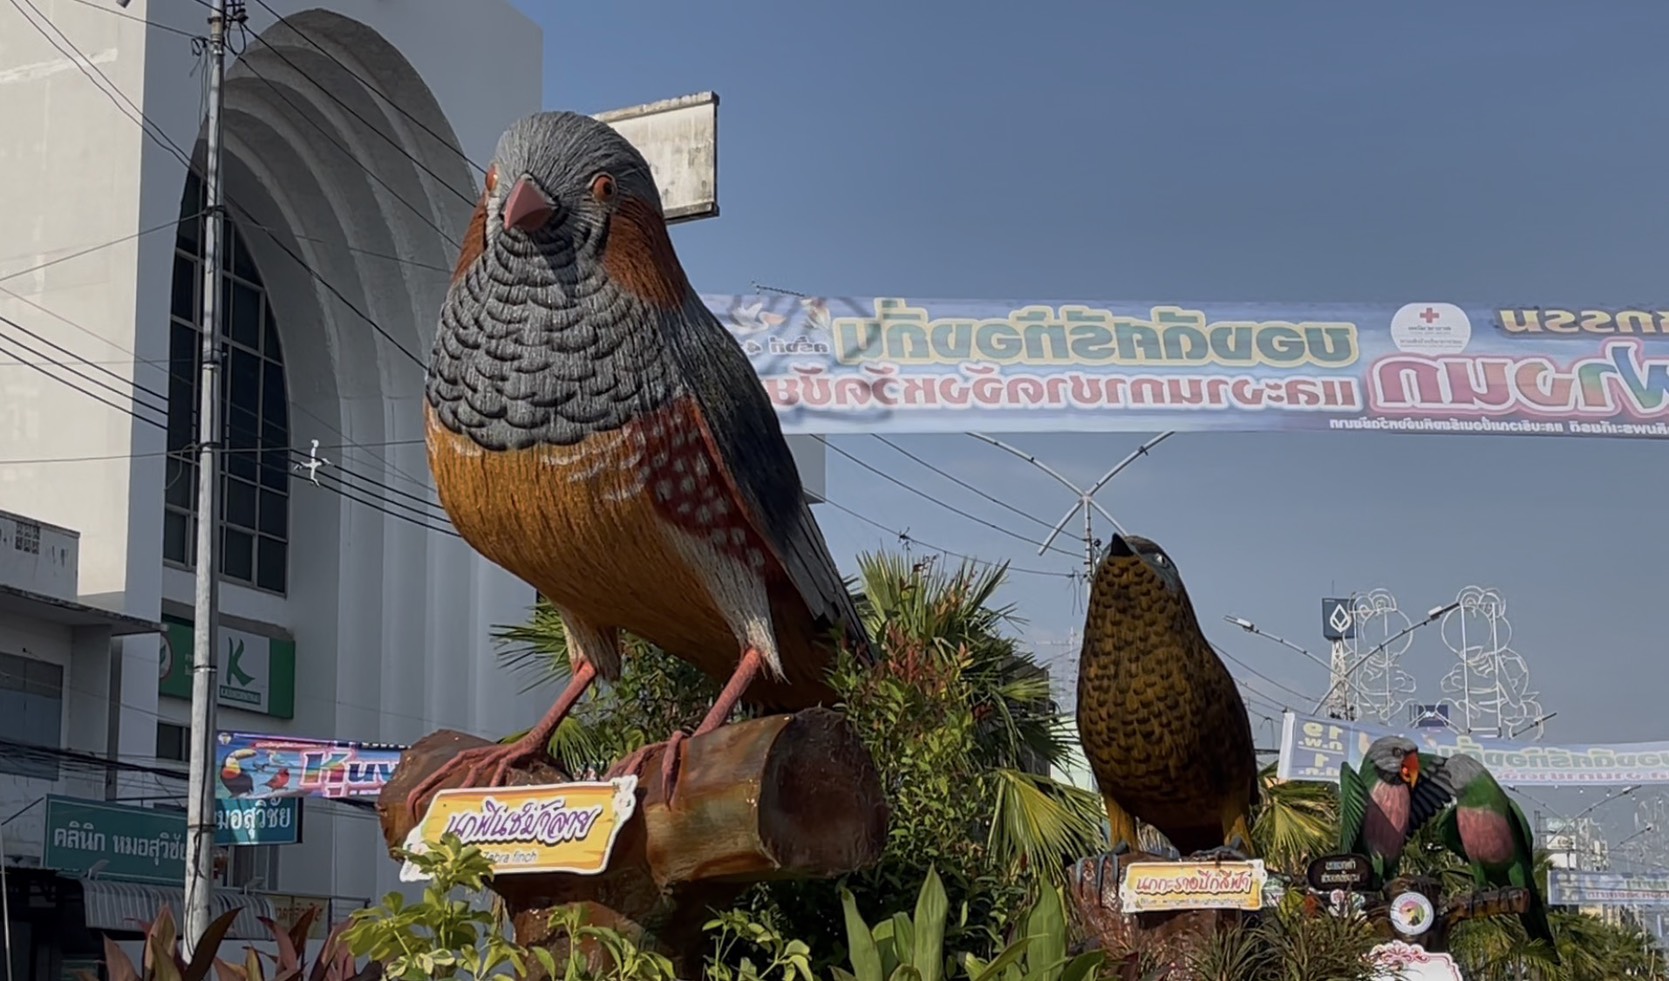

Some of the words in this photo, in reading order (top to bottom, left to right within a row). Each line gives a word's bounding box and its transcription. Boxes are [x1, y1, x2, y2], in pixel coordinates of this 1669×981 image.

[214, 797, 291, 839] มอสุวิชัย
[54, 820, 106, 851] คลินิก
[512, 850, 537, 864] finch
